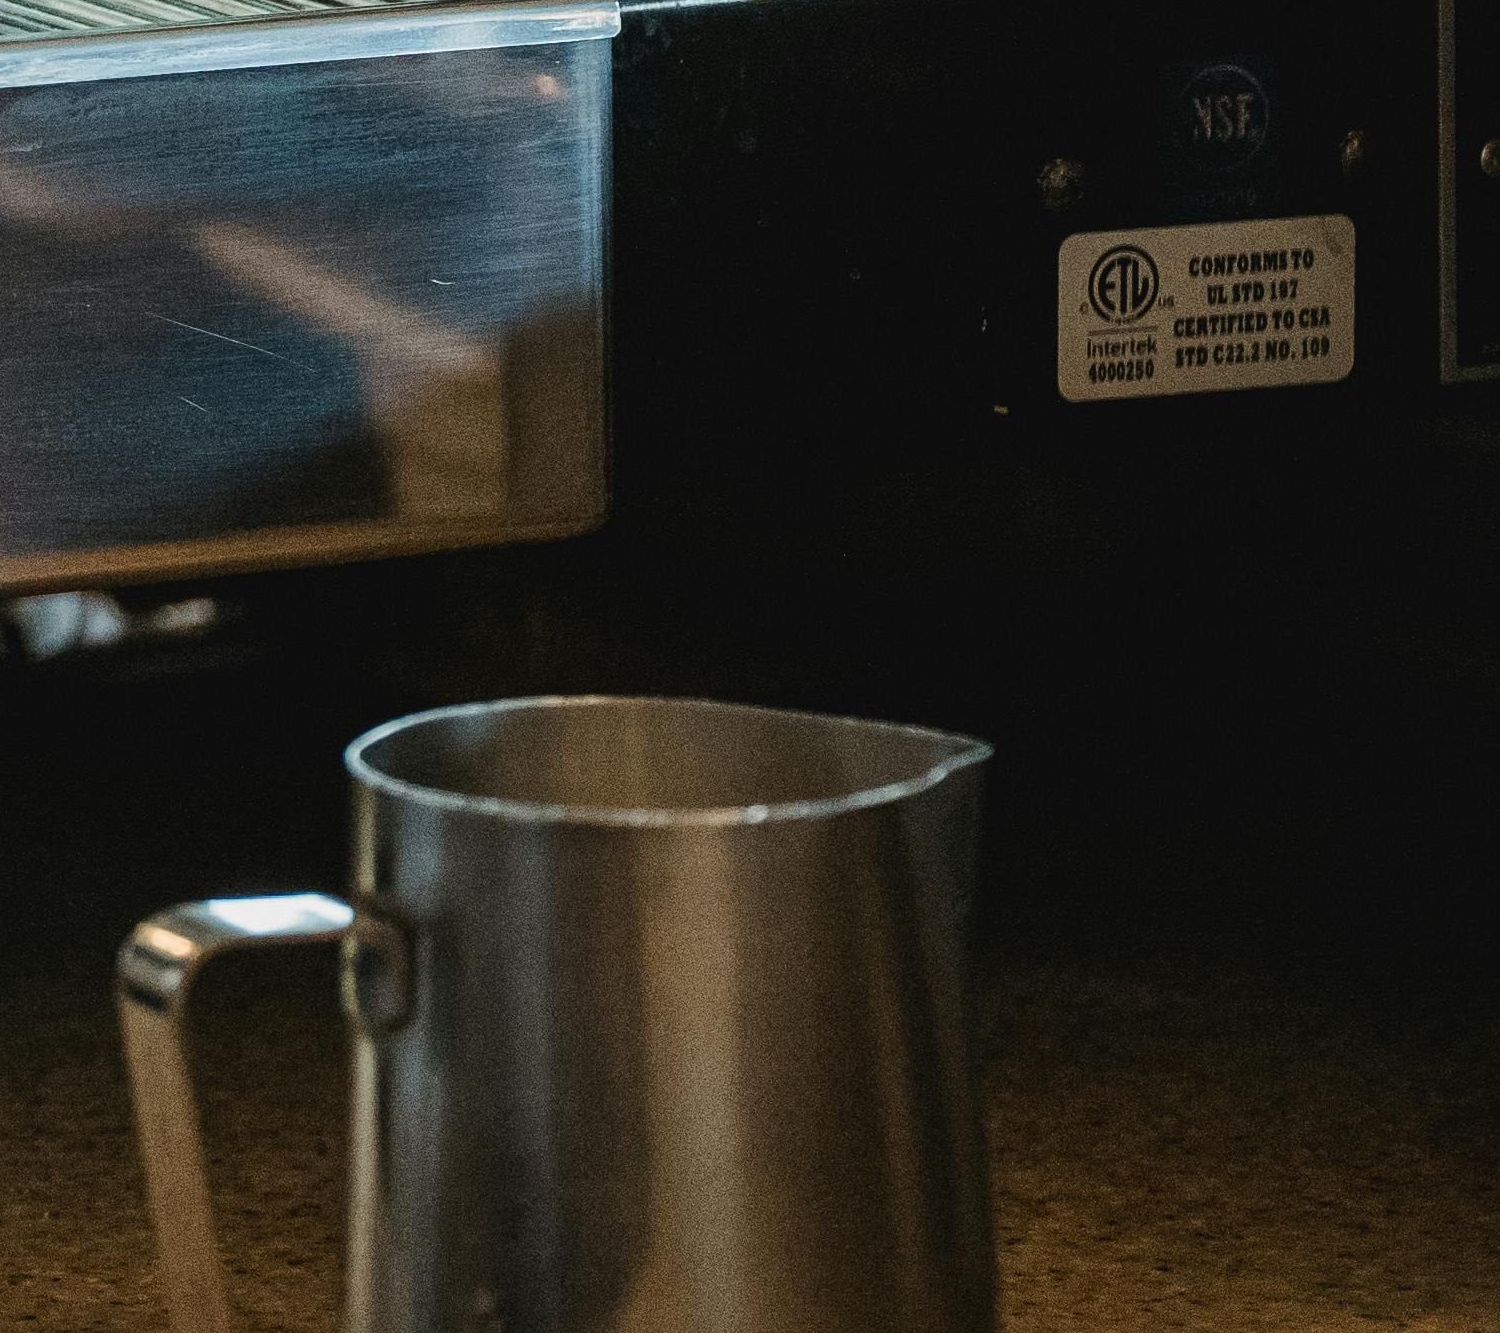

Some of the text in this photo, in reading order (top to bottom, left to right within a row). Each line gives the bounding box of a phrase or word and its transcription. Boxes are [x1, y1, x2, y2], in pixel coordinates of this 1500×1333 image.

[1192, 92, 1253, 140] NSF
[1189, 247, 1315, 278] CONFORMS TO
[1098, 255, 1150, 316] ETL
[1207, 283, 1228, 306] UL
[1232, 281, 1265, 305] STD
[1173, 305, 1332, 339] CERTIFIED TO CSA
[1086, 335, 1157, 359] Intertek
[1175, 334, 1331, 369] STD C22.2 NO. 109
[1088, 358, 1154, 384] 4000250
